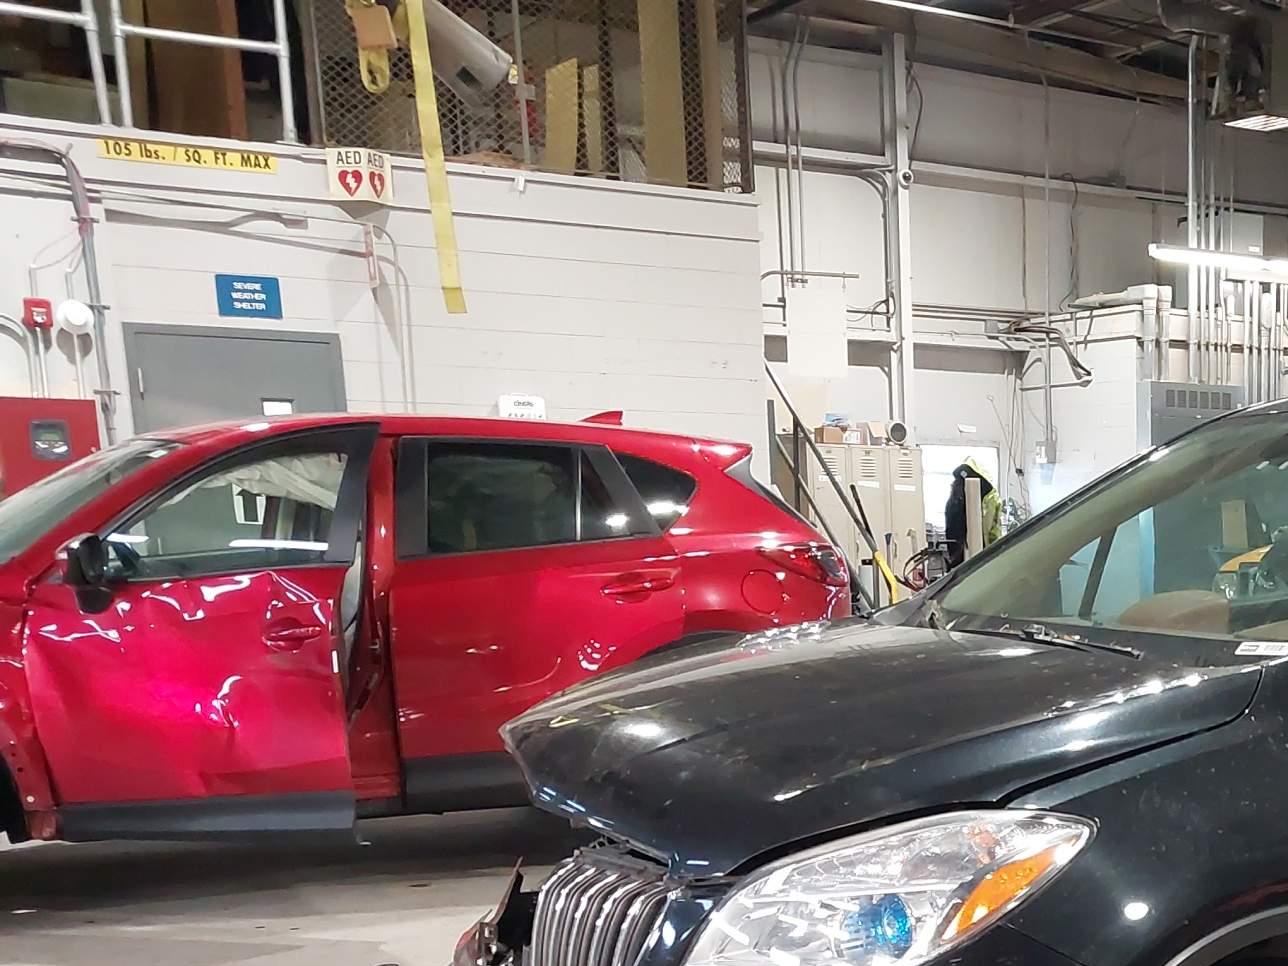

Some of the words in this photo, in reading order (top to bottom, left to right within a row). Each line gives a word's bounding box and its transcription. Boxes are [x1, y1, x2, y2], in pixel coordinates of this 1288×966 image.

[103, 140, 132, 157] 105
[139, 143, 166, 160] lbs.
[185, 148, 208, 165] SQ.
[214, 151, 234, 167] FT.
[240, 154, 272, 170] MAX
[336, 150, 362, 165] AED
[367, 152, 384, 169] AED
[232, 281, 262, 291] SEVERE
[230, 291, 267, 301] WEATHER
[232, 301, 267, 310] SHELTER
